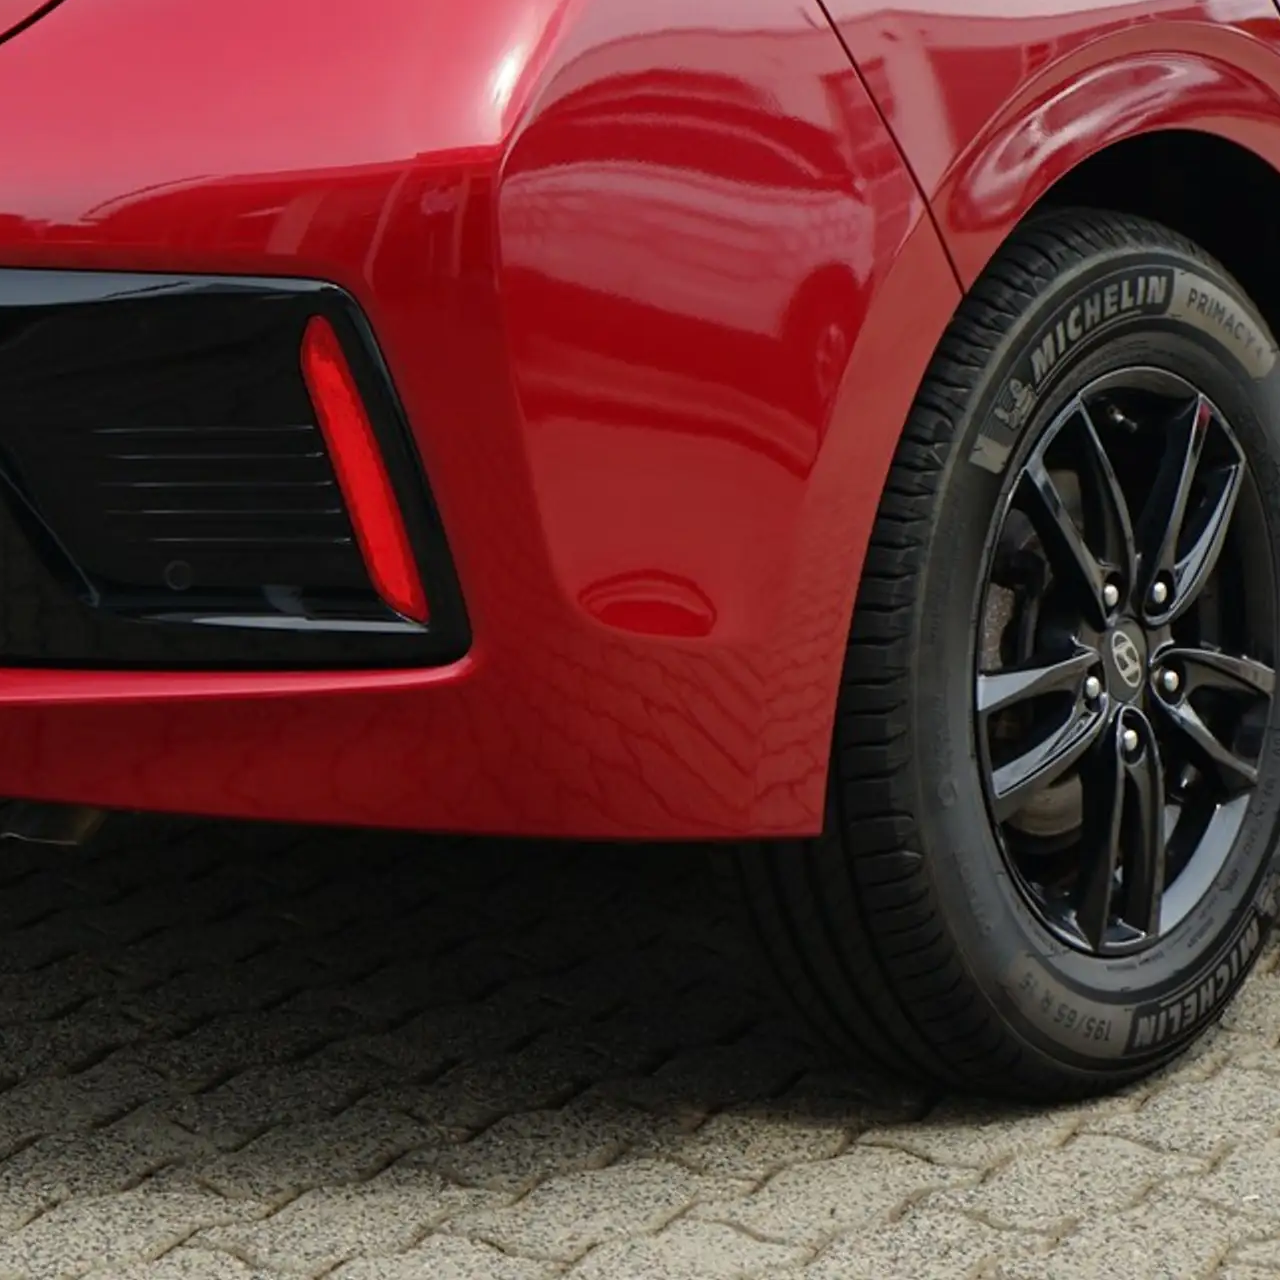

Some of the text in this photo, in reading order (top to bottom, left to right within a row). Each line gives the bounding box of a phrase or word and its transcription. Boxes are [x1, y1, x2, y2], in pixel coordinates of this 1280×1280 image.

[1030, 275, 1168, 380] MICHELIN
[1186, 287, 1257, 349] PRIMACY
[1132, 918, 1260, 1049] MICHELIN
